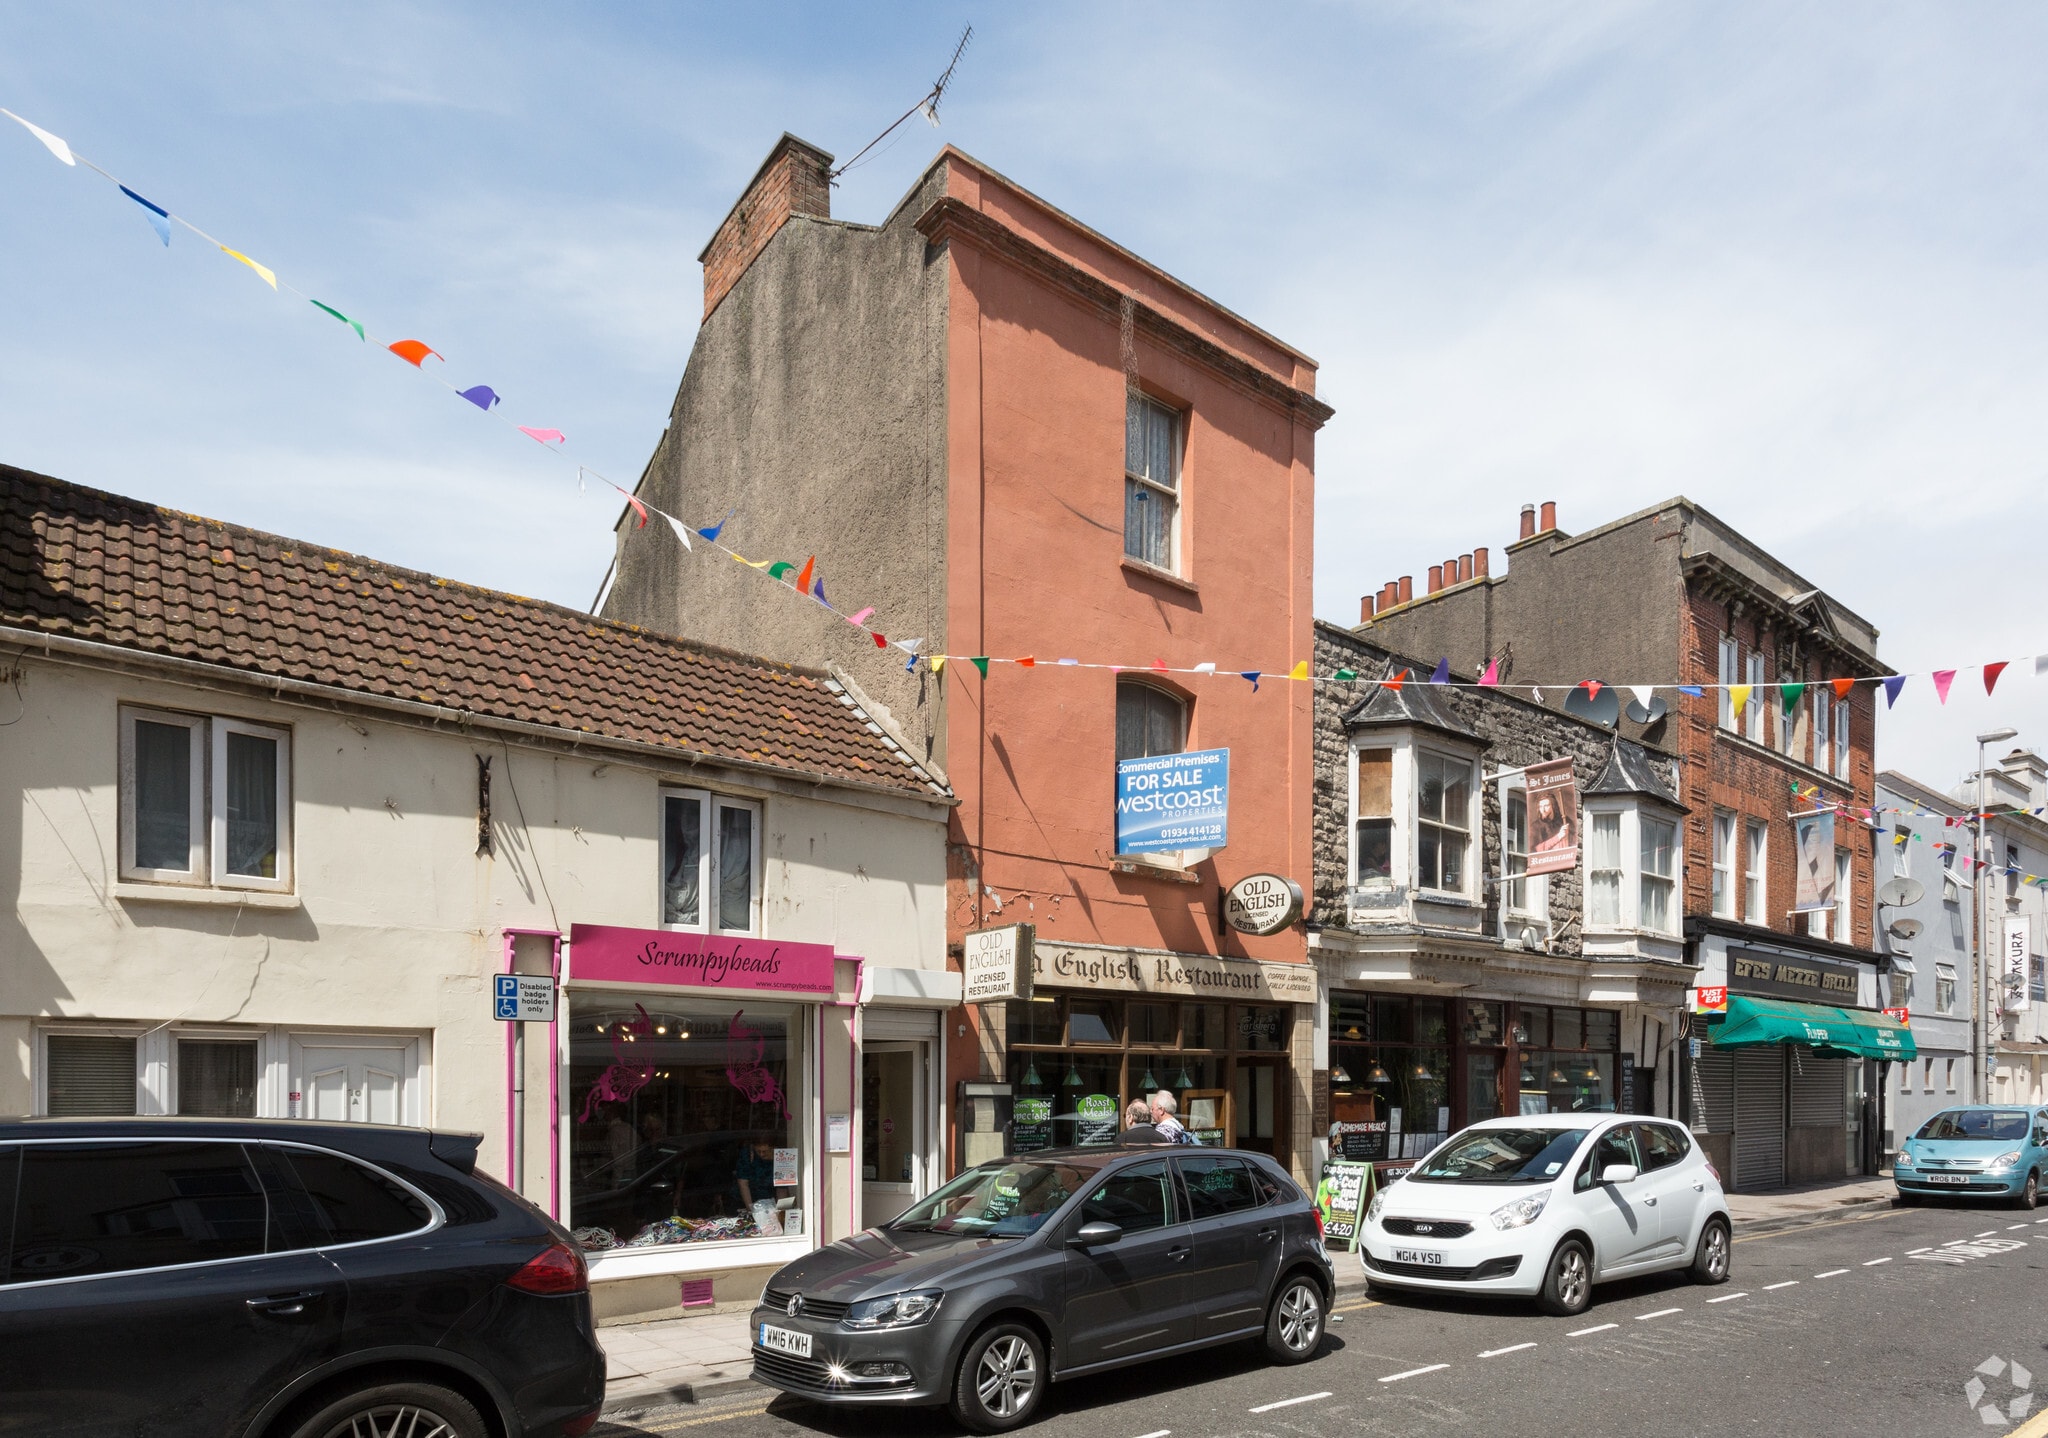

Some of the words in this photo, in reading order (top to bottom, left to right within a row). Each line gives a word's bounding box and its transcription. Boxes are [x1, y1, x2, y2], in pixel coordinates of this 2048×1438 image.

[1117, 757, 1173, 774] Commercial
[1175, 754, 1220, 768] Premises
[1127, 774, 1159, 792] FOR
[1162, 769, 1203, 788] SALE
[1529, 777, 1541, 787] St
[1543, 771, 1571, 786] James
[1116, 785, 1223, 814] westcoast
[1162, 805, 1223, 818] PROPERTIES
[1161, 828, 1188, 838] 01934
[1189, 825, 1222, 835] 414128
[1531, 852, 1574, 866] Restaurant
[1244, 880, 1271, 897] OLD
[1230, 893, 1286, 913] ENGLISH
[1245, 910, 1269, 919] LICENSED
[1234, 913, 1280, 931] RESTAURANT
[979, 932, 1003, 951] OLD
[637, 941, 782, 983] Scrumpybeads
[969, 949, 1012, 970] ENGLISH
[973, 971, 1007, 984] LICENSED
[1055, 951, 1142, 983] English
[1156, 958, 1261, 991] Restaurant
[1267, 972, 1287, 980] COFFEE
[1774, 964, 1820, 988] MEZZE
[520, 983, 552, 991] Disabled
[755, 980, 832, 991] www.scrumpybeads.com
[968, 983, 1011, 996] RESTAURANT
[1286, 984, 1312, 992] LICENSED
[524, 991, 547, 999] badge
[1701, 988, 1723, 998] JUST
[1705, 995, 1723, 1004] EAT
[1031, 1100, 1052, 1108] made
[1086, 1096, 1110, 1108] Roast
[1083, 1106, 1113, 1118] Meals!
[1340, 1122, 1367, 1133] HOMEMADE
[1368, 1121, 1387, 1132] MEALS!
[1341, 1175, 1361, 1189] Cod
[1341, 1188, 1359, 1199] and
[1396, 1250, 1418, 1262] WG14
[1421, 1252, 1442, 1265] VSD
[767, 1328, 786, 1348] WM16
[788, 1333, 809, 1354] KWH
